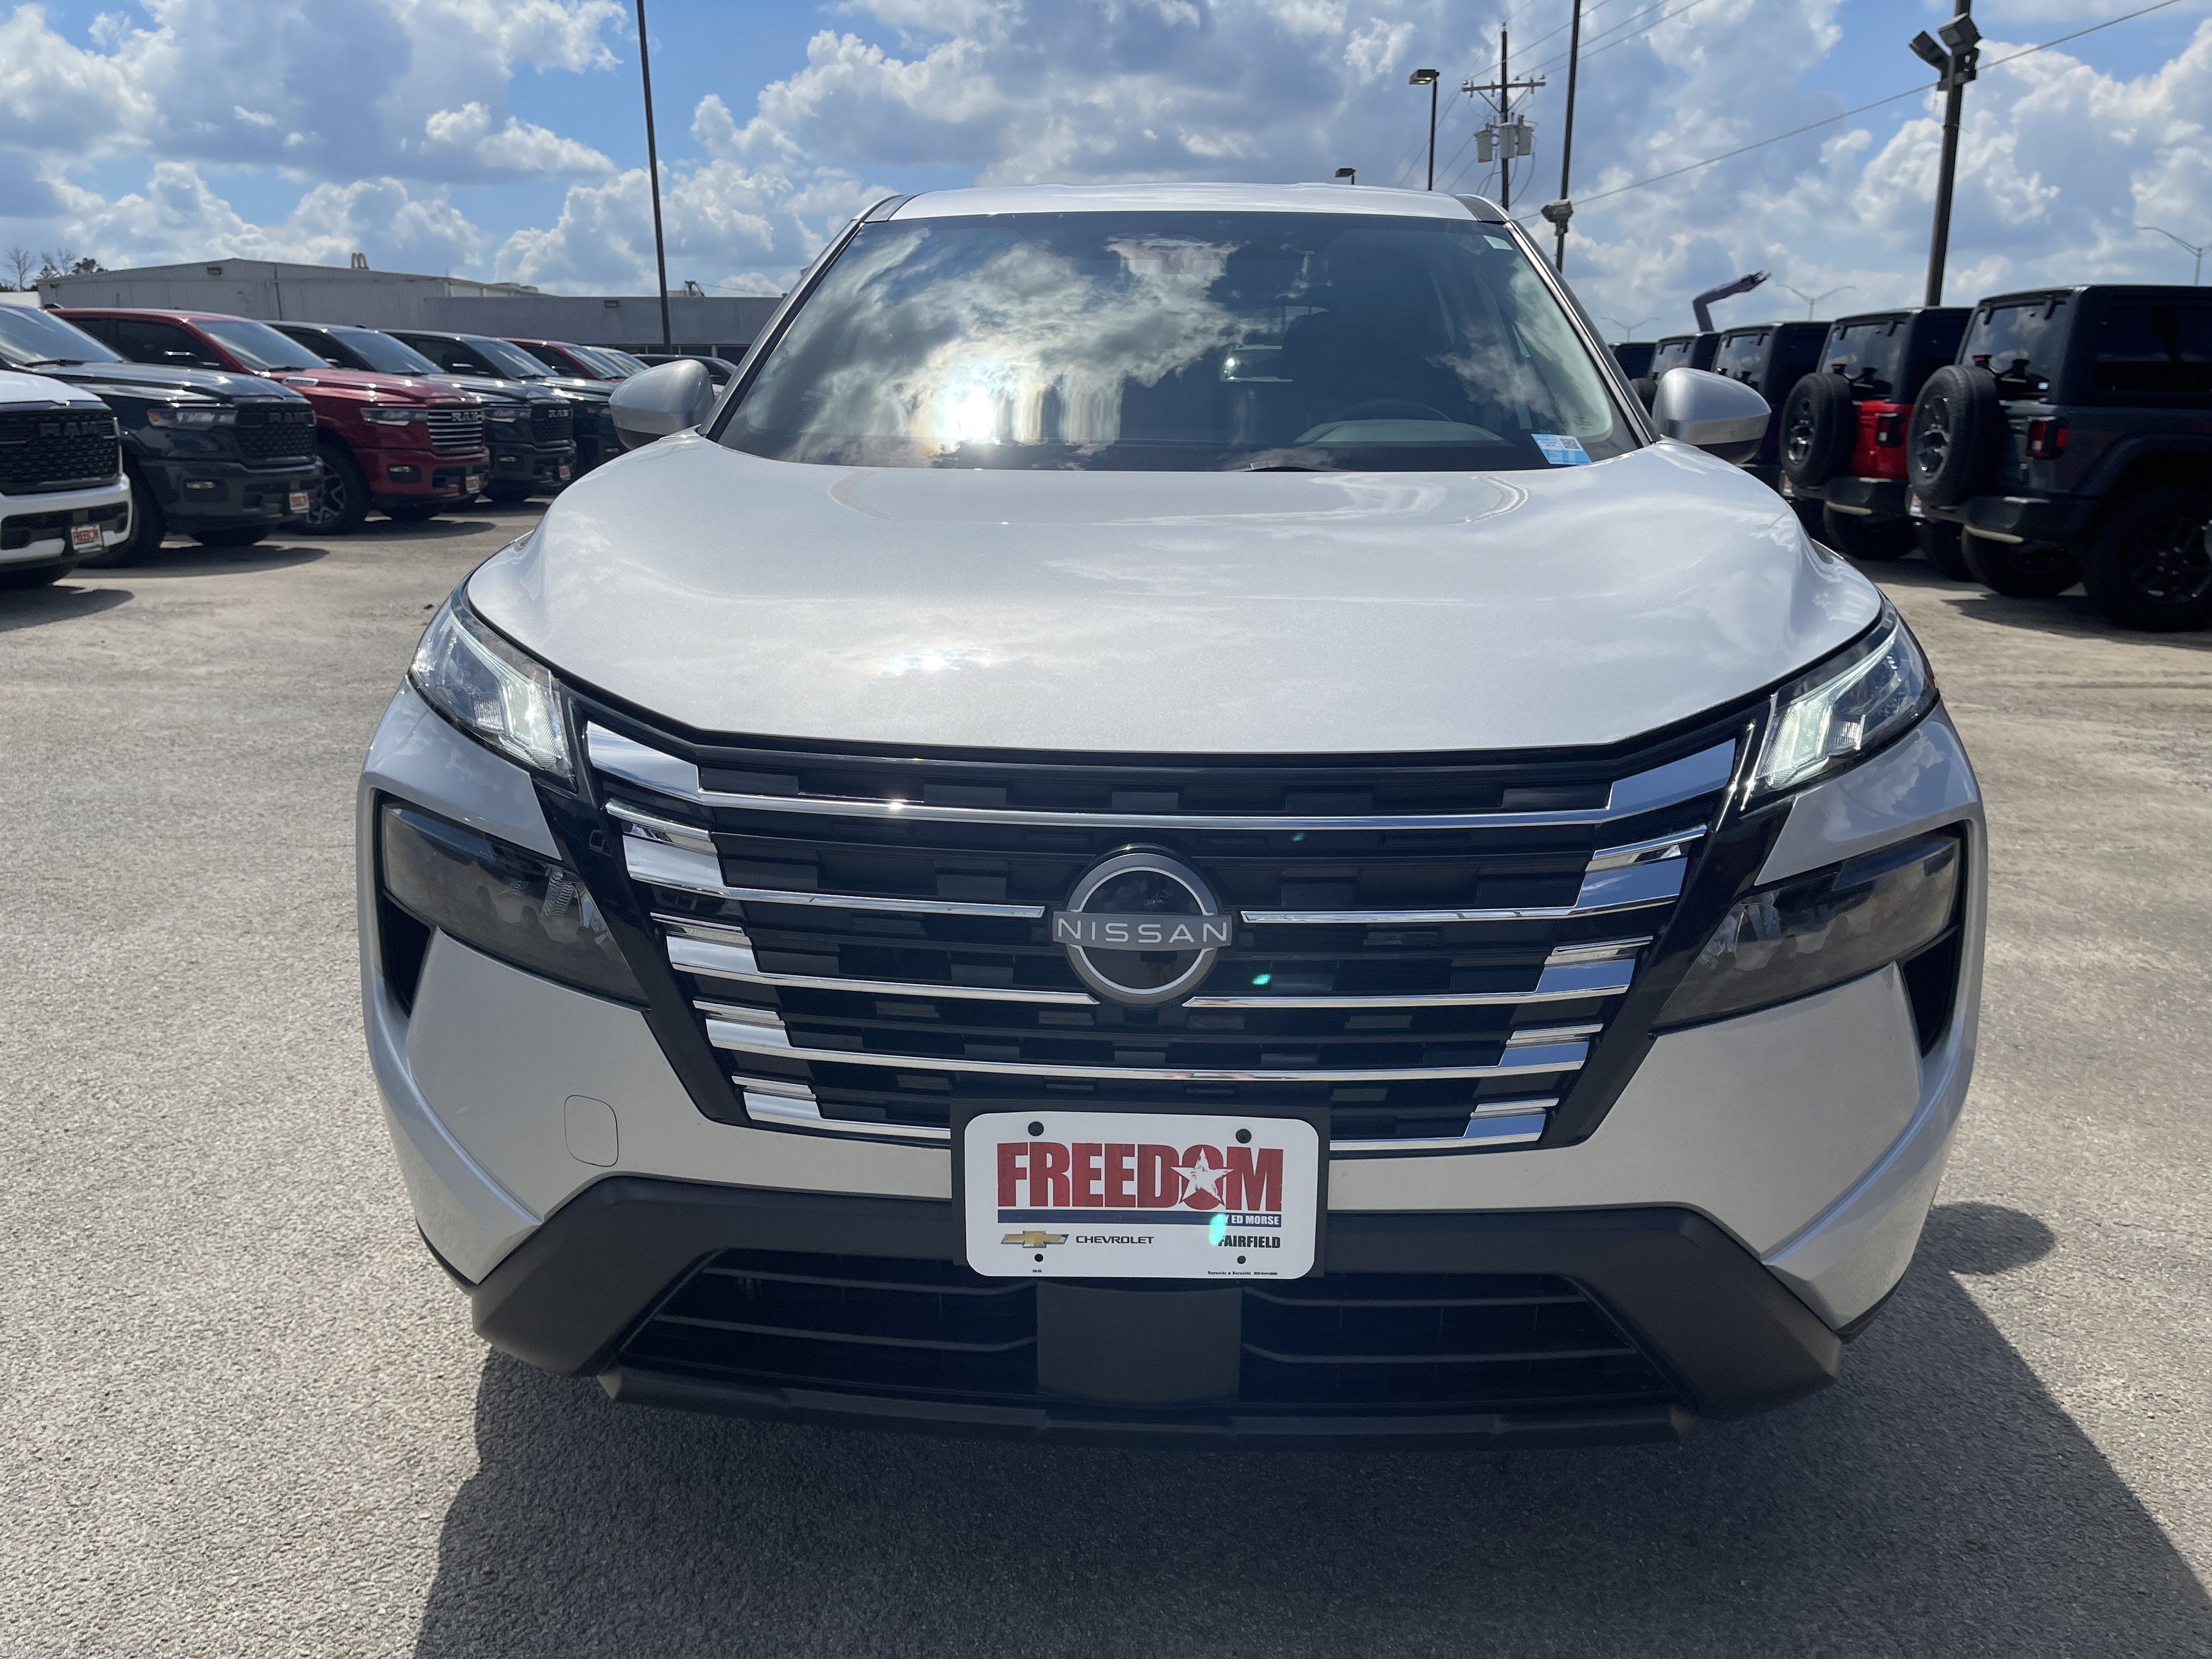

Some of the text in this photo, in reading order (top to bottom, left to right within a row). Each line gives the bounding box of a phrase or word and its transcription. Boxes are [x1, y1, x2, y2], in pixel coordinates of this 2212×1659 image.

[1057, 918, 1227, 944] NISSAN
[997, 1142, 1284, 1211] FREEDOM
[1231, 1215, 1244, 1224] ED
[1245, 1215, 1279, 1225] MORSE
[1076, 1235, 1155, 1244] CHEVROLET
